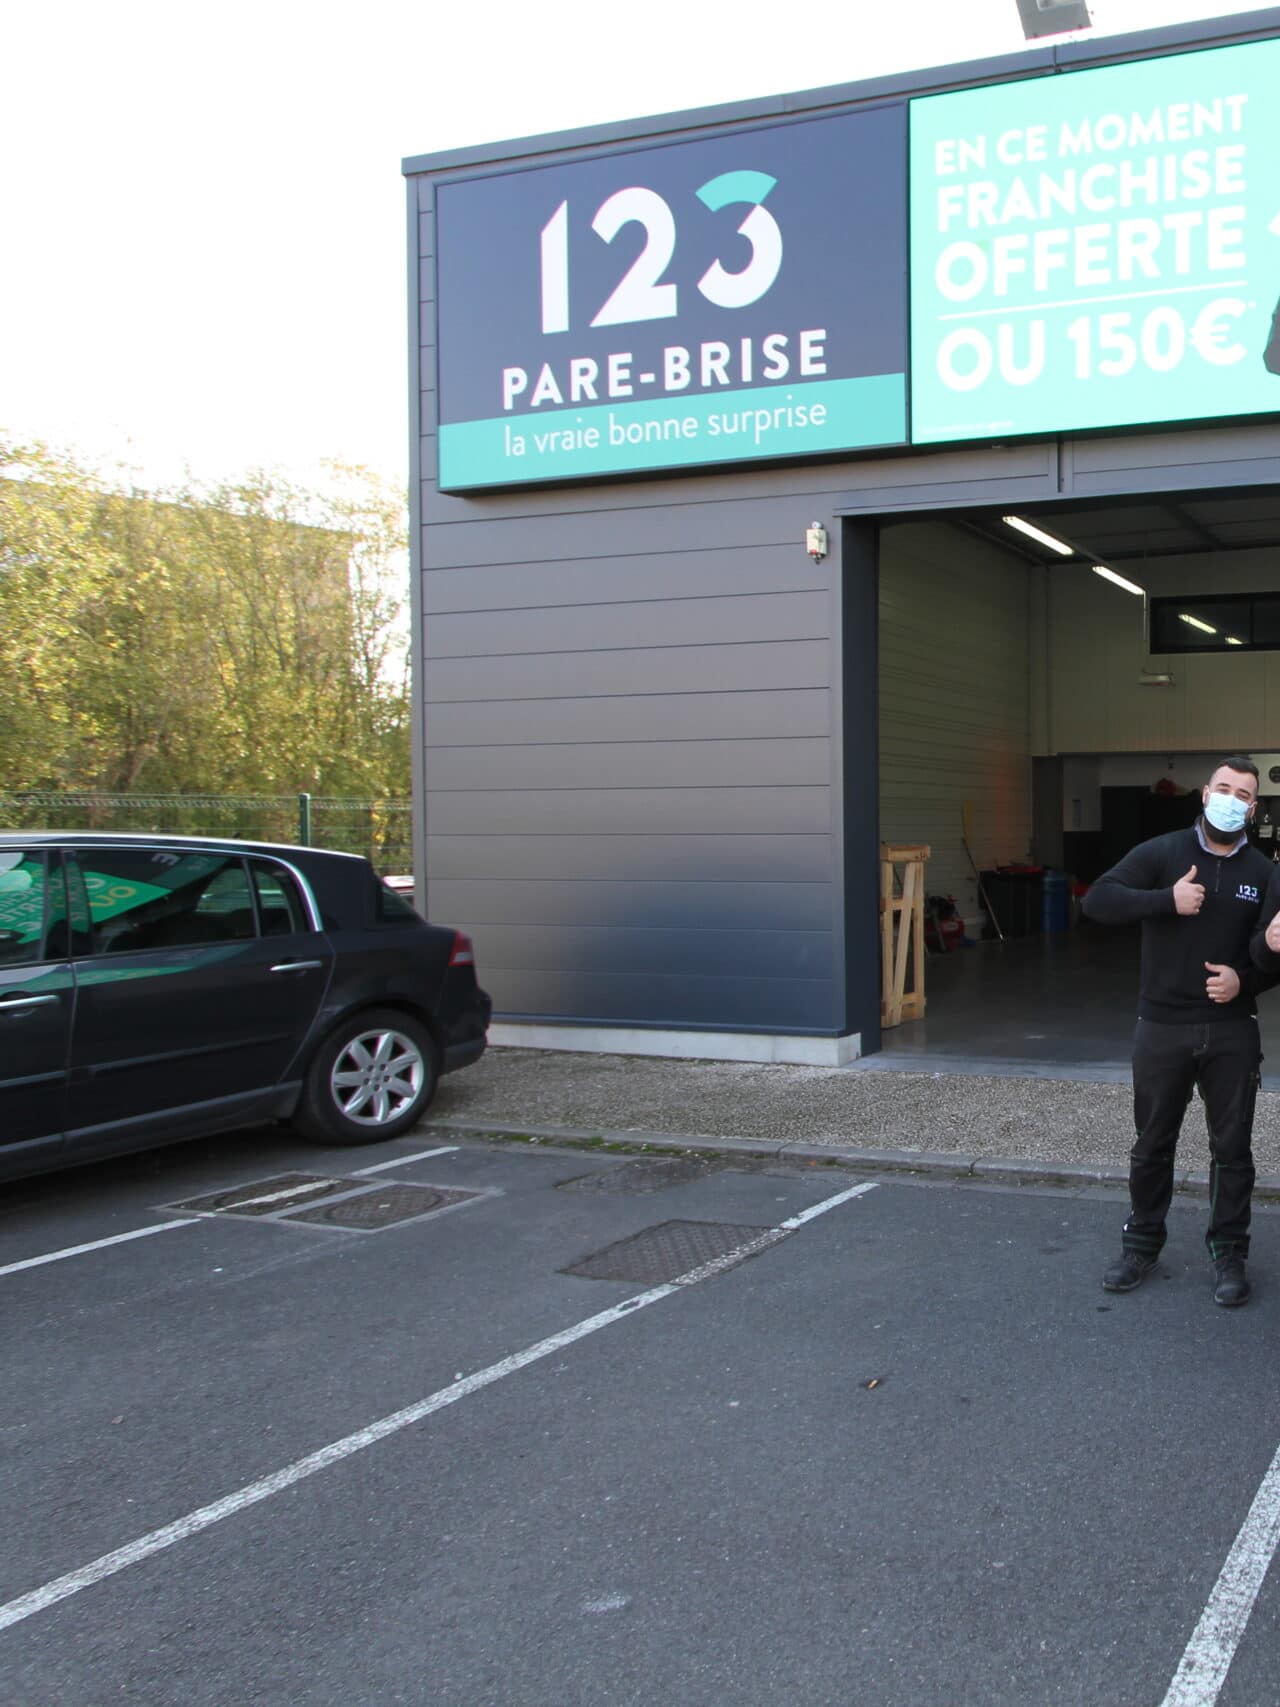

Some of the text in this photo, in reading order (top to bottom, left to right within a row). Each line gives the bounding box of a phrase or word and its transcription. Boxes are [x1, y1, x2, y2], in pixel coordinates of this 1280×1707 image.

[934, 95, 1249, 176] EN CE MOMENT
[936, 144, 1247, 233] FRANCHISE
[540, 169, 783, 334] 123
[935, 205, 1247, 302] OFFERTE
[503, 329, 827, 410] PARE-BRISE
[936, 318, 1045, 392] OU
[505, 394, 827, 457] la vraie bonne surprise
[1239, 885, 1258, 898] 123
